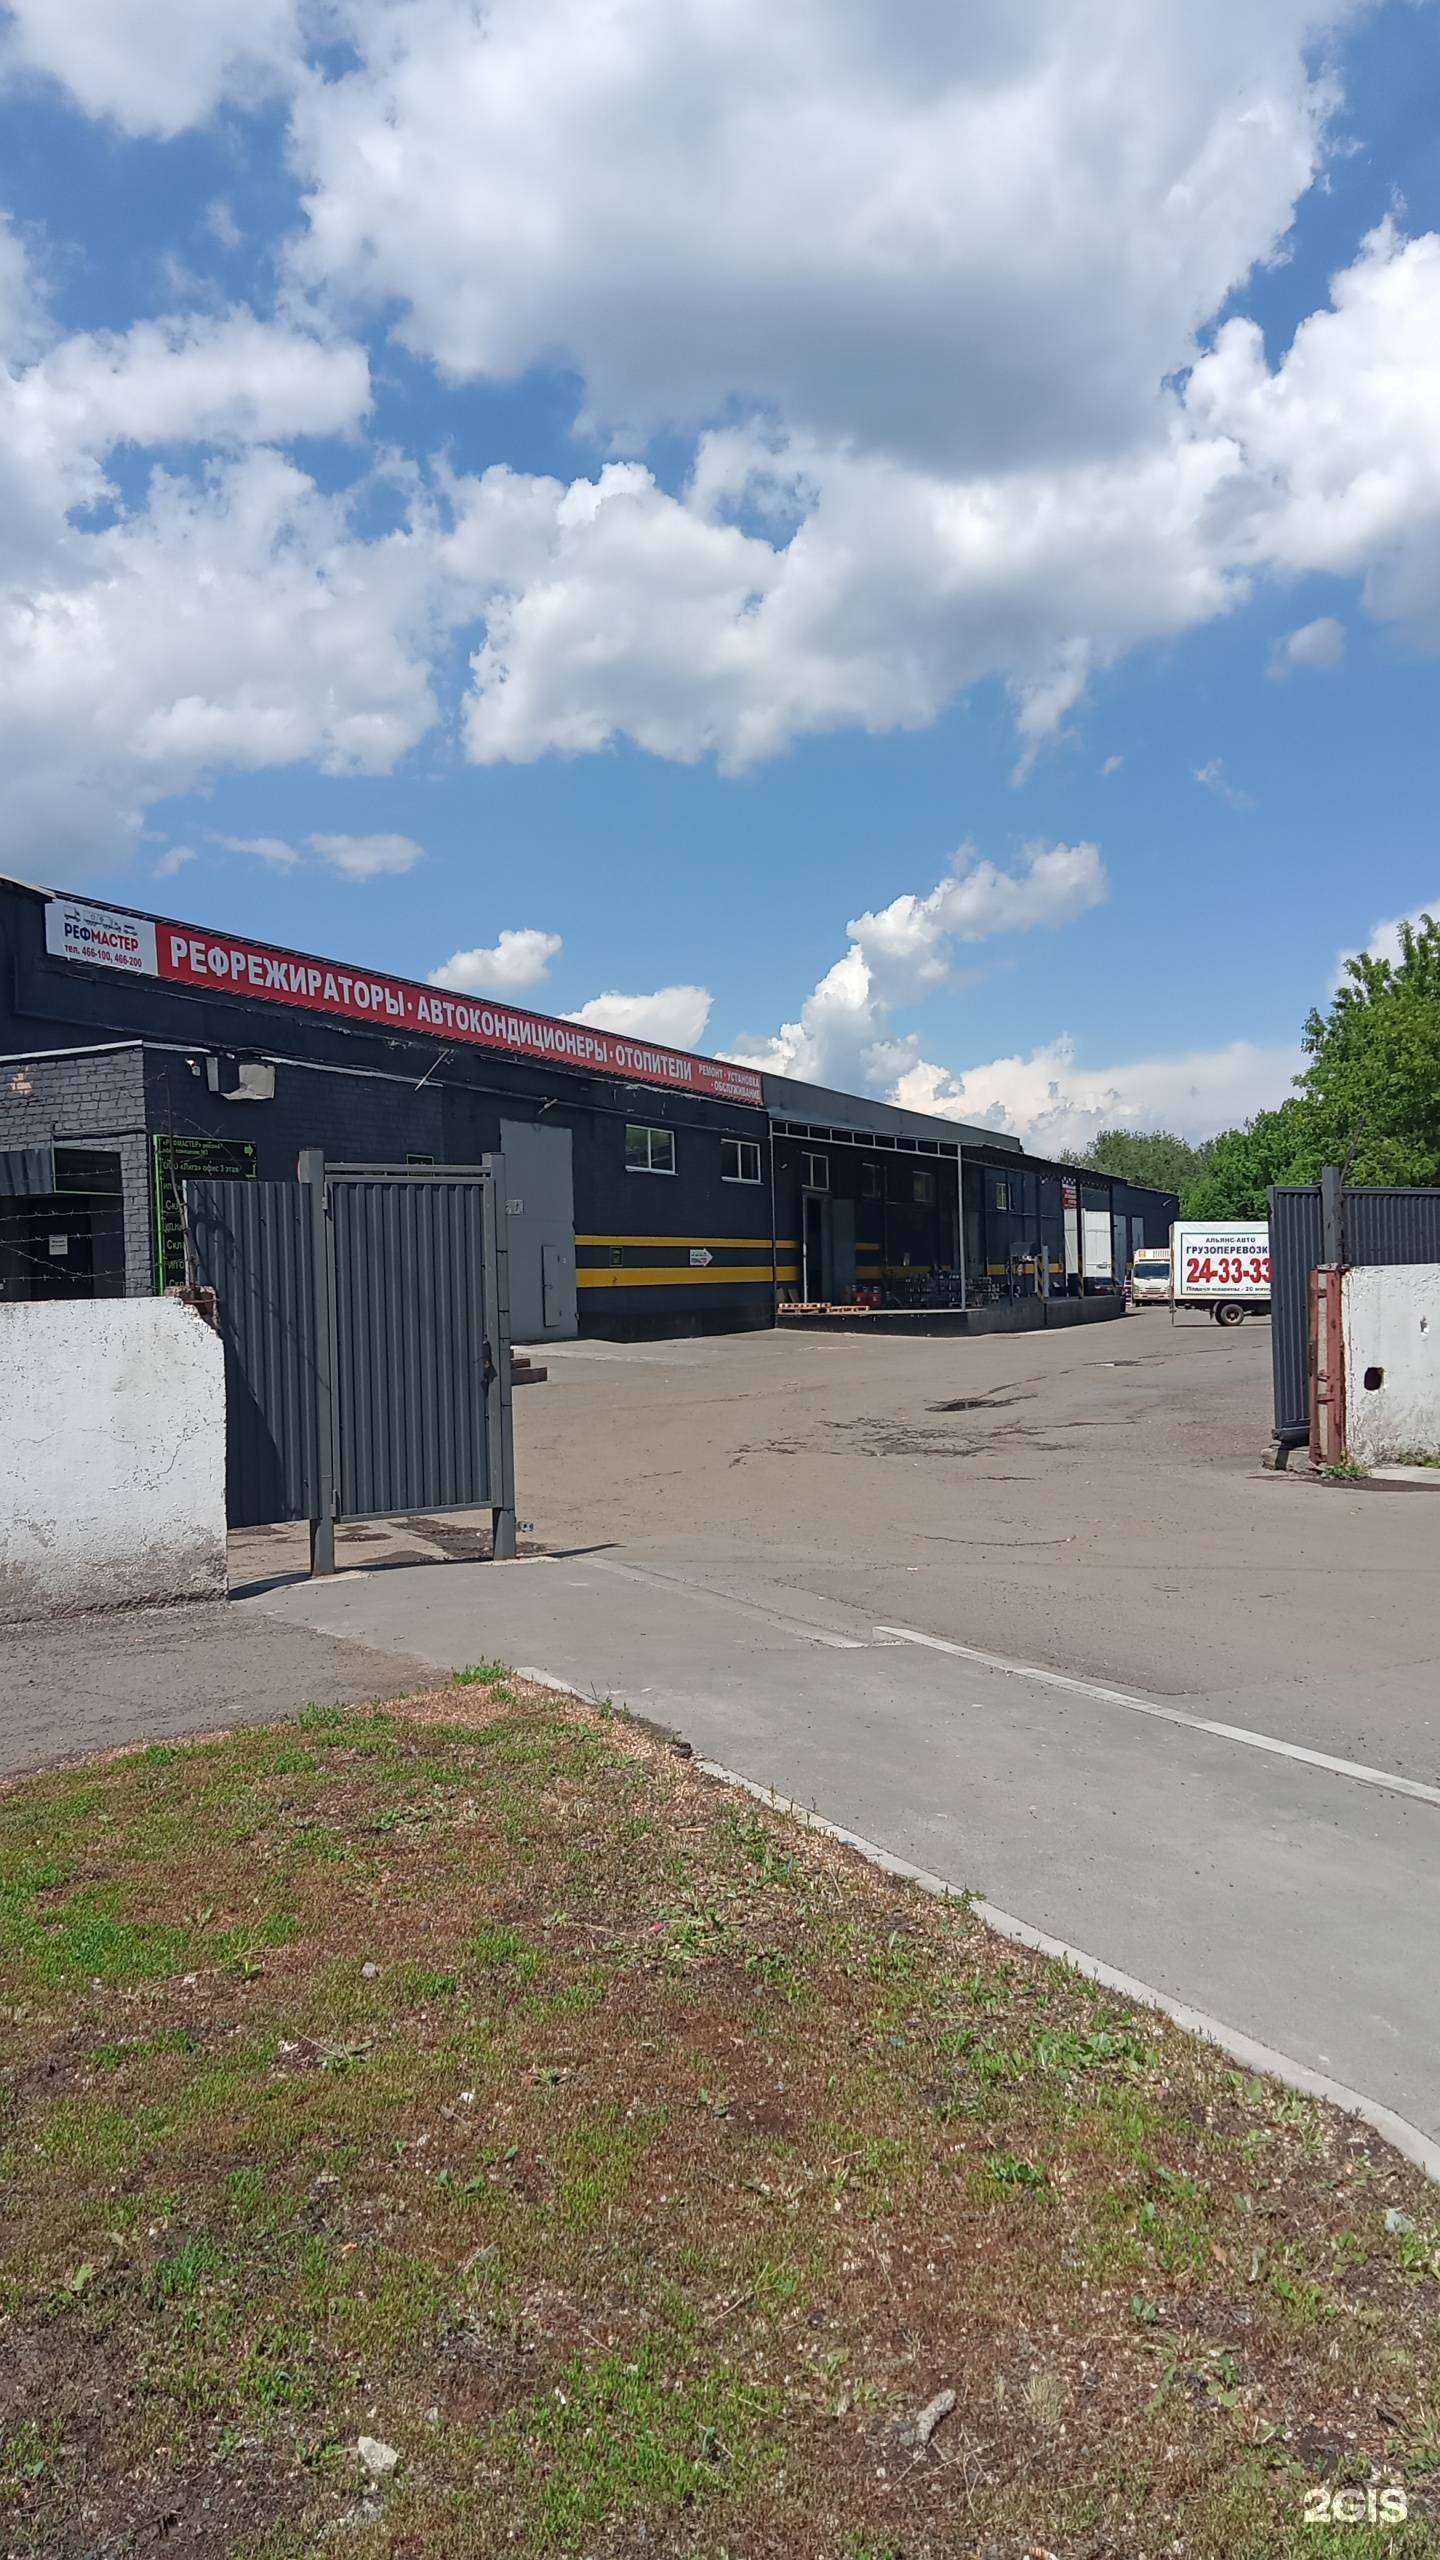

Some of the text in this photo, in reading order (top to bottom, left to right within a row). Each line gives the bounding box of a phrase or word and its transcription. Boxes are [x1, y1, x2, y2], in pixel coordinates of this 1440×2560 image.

[64, 922, 139, 952] РЕФМАСТЕР
[64, 944, 80, 955] тел.
[114, 952, 142, 968] 466-200
[170, 935, 693, 1082] РЕФРЕЖИРАТОРЫ АВТОКОНДИЦИОНЕРЫ ОТОПИТЕЛИ
[698, 1063, 760, 1088] РЕМОНТ УСТАНОВКА
[1186, 1257, 1273, 1284] 24-33-33
